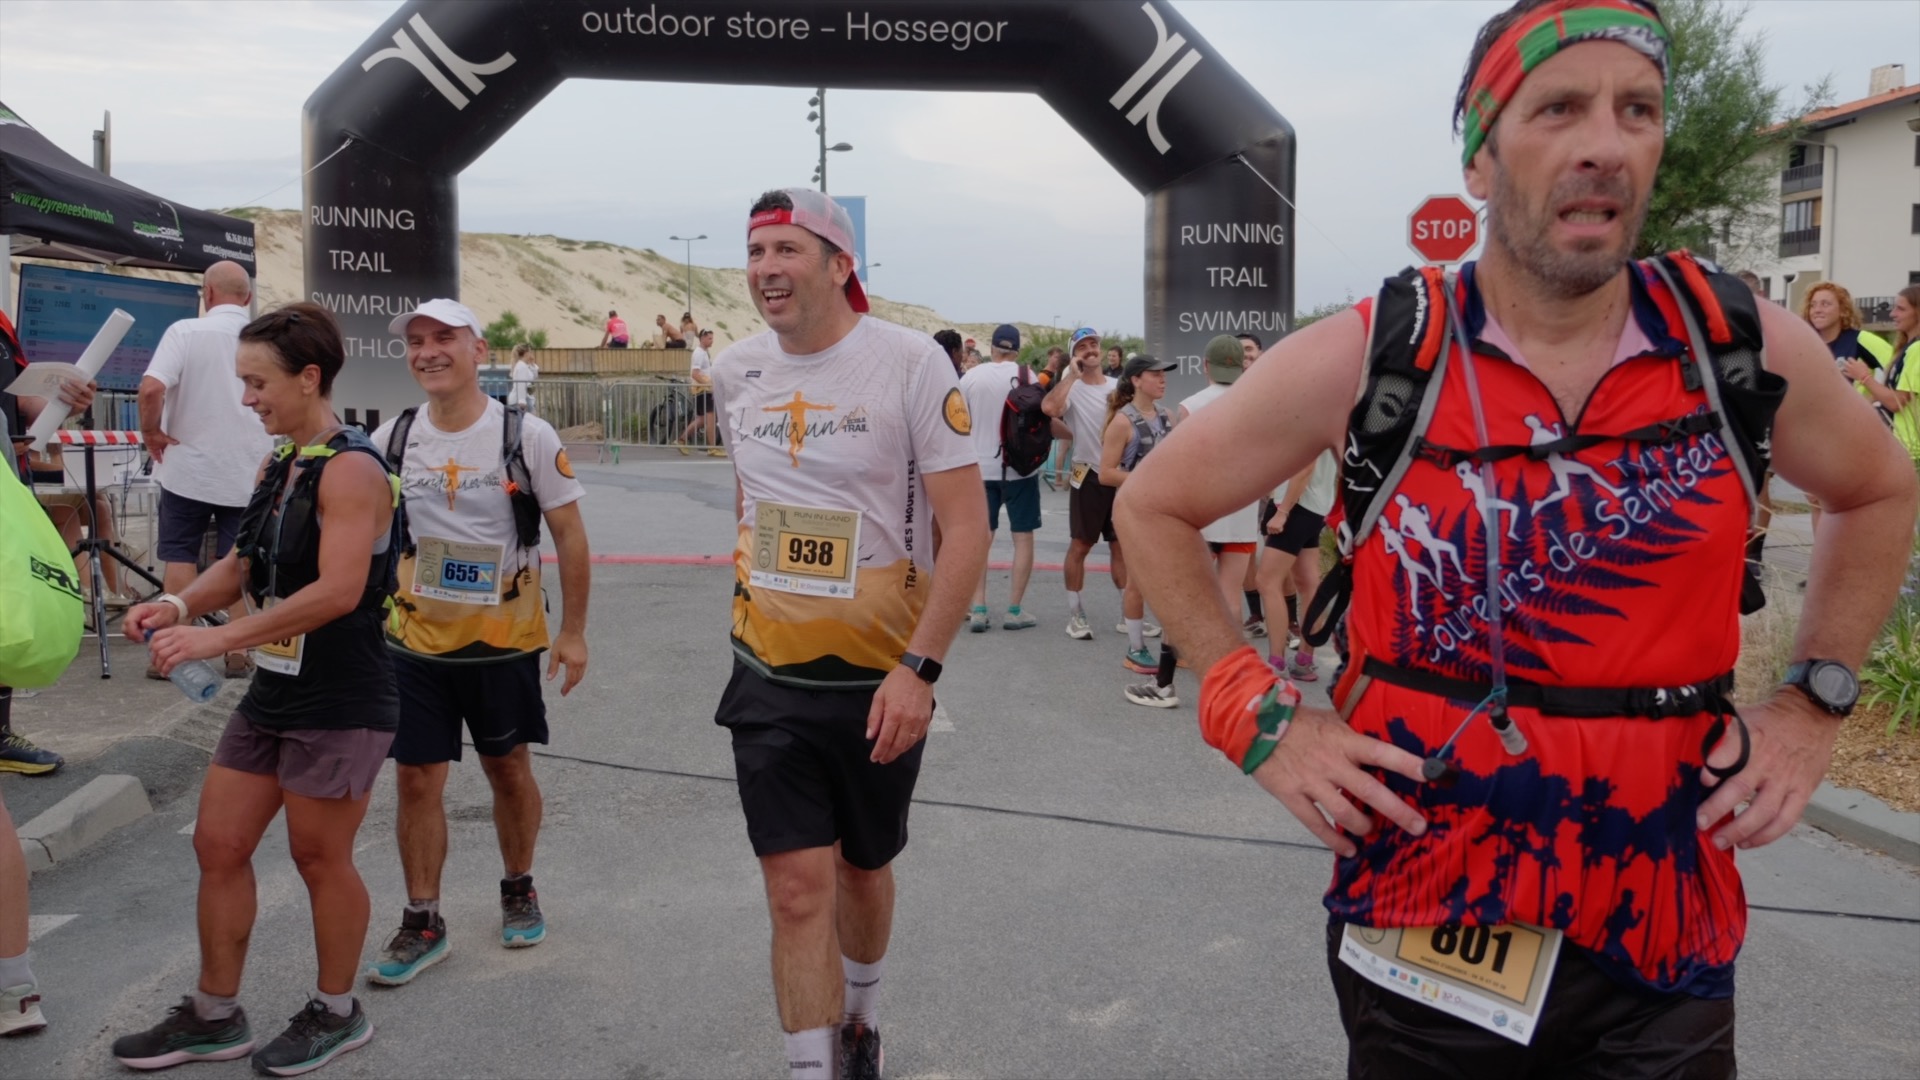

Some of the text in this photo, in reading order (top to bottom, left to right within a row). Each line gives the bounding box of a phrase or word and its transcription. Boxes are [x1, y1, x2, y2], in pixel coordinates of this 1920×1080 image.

[582, 4, 715, 37] outdoor
[727, 10, 810, 39] store
[846, 11, 1008, 51] Hossegor
[311, 205, 415, 230] RUNNING
[1181, 223, 1284, 246] RUNNING
[1415, 219, 1472, 240] STOP
[329, 250, 392, 272] TRAIL
[1206, 267, 1268, 287] TRAIL
[311, 291, 421, 316] SWIMRUN
[1178, 310, 1287, 332] SWIMRUN
[905, 460, 915, 524] MOUETTES
[825, 513, 851, 523] LAND
[905, 528, 913, 551] DES
[1548, 529, 1597, 573] de
[788, 537, 834, 566] 938
[444, 561, 479, 583] 655
[1430, 924, 1513, 974] 801
